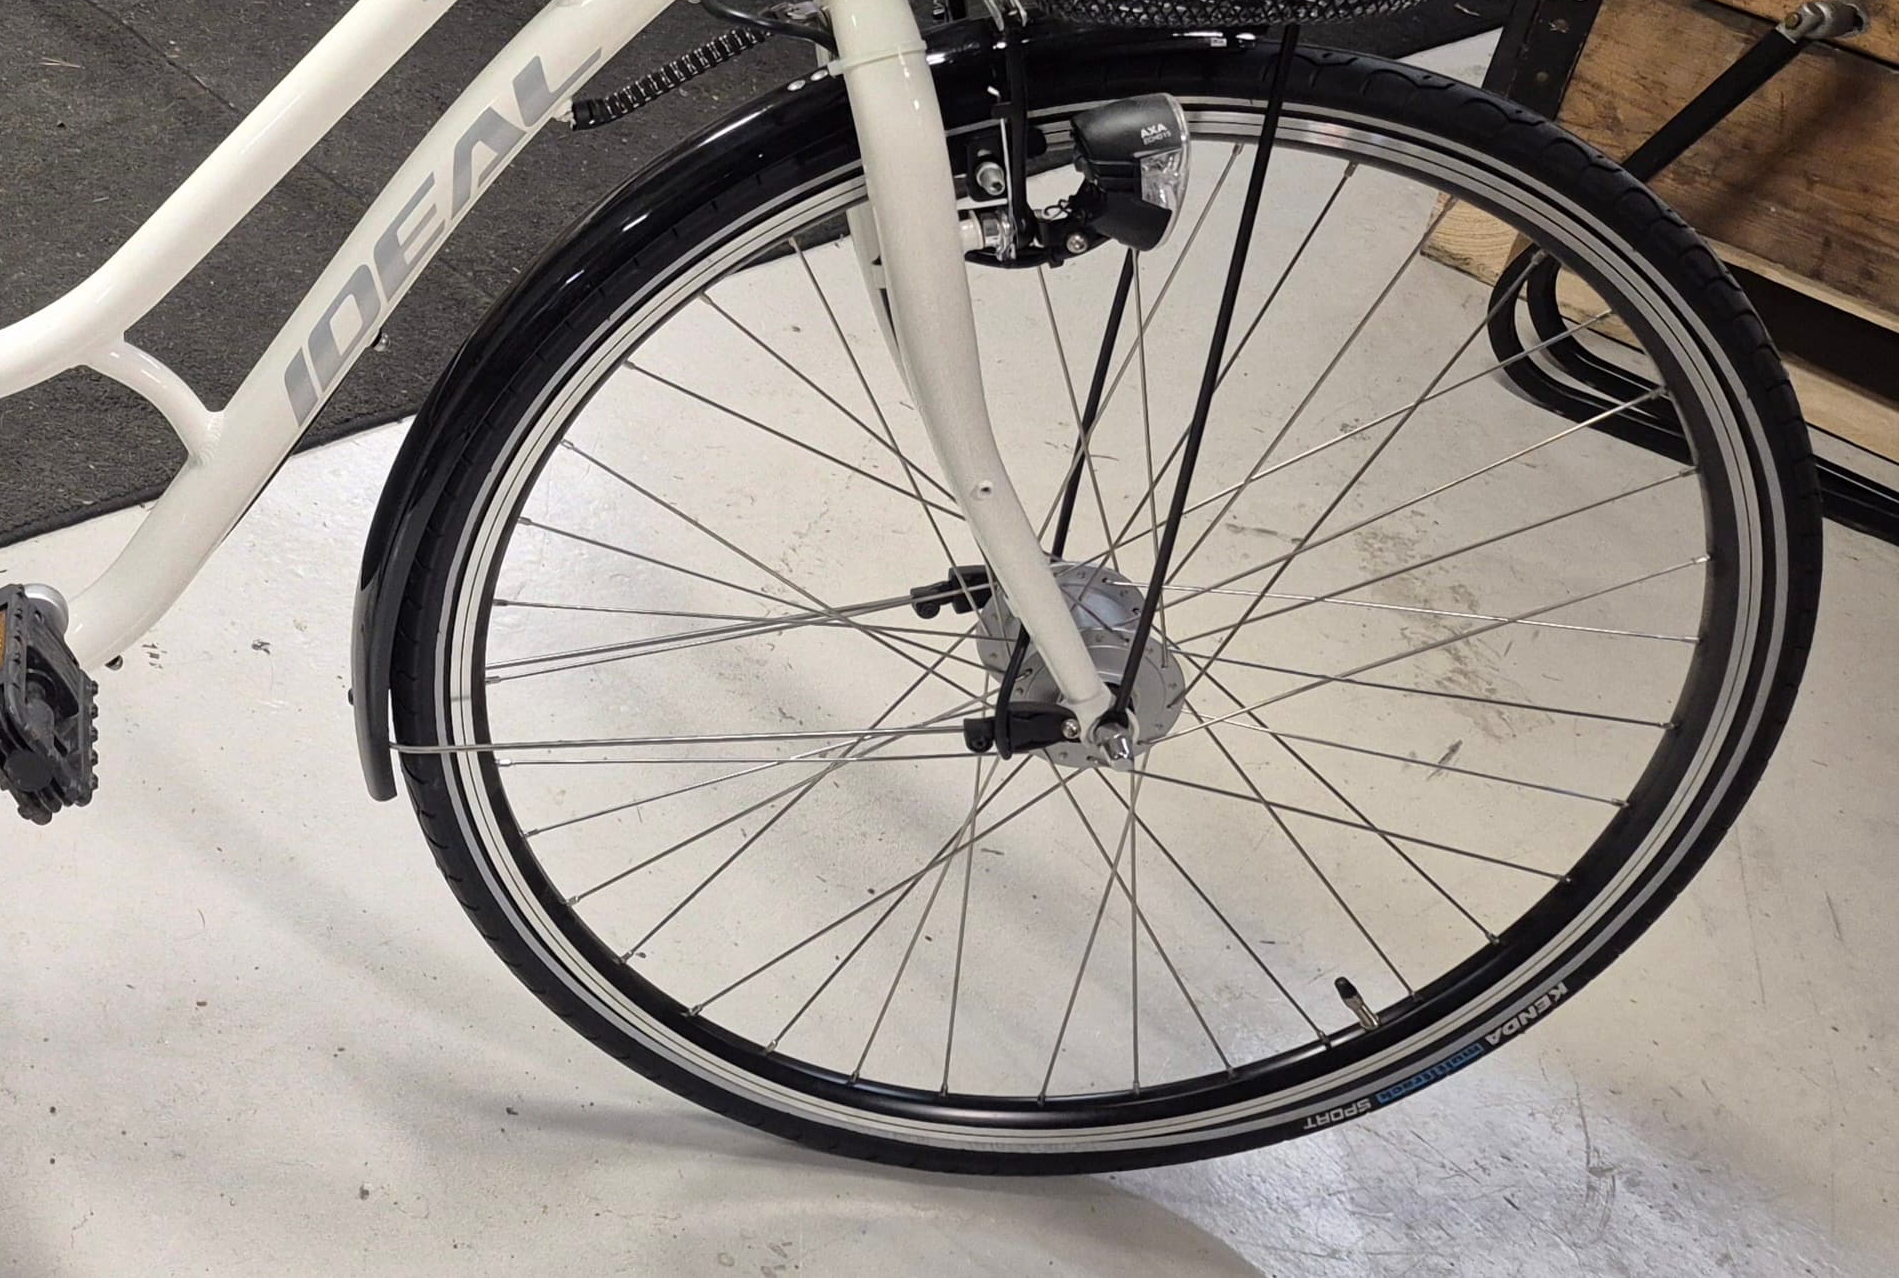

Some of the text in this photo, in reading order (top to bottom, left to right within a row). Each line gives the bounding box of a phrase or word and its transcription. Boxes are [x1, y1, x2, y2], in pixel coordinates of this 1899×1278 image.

[1141, 123, 1167, 138] AXA
[283, 46, 603, 429] IDEAL
[1303, 981, 1568, 1130] KENDA multitrack SPORT
